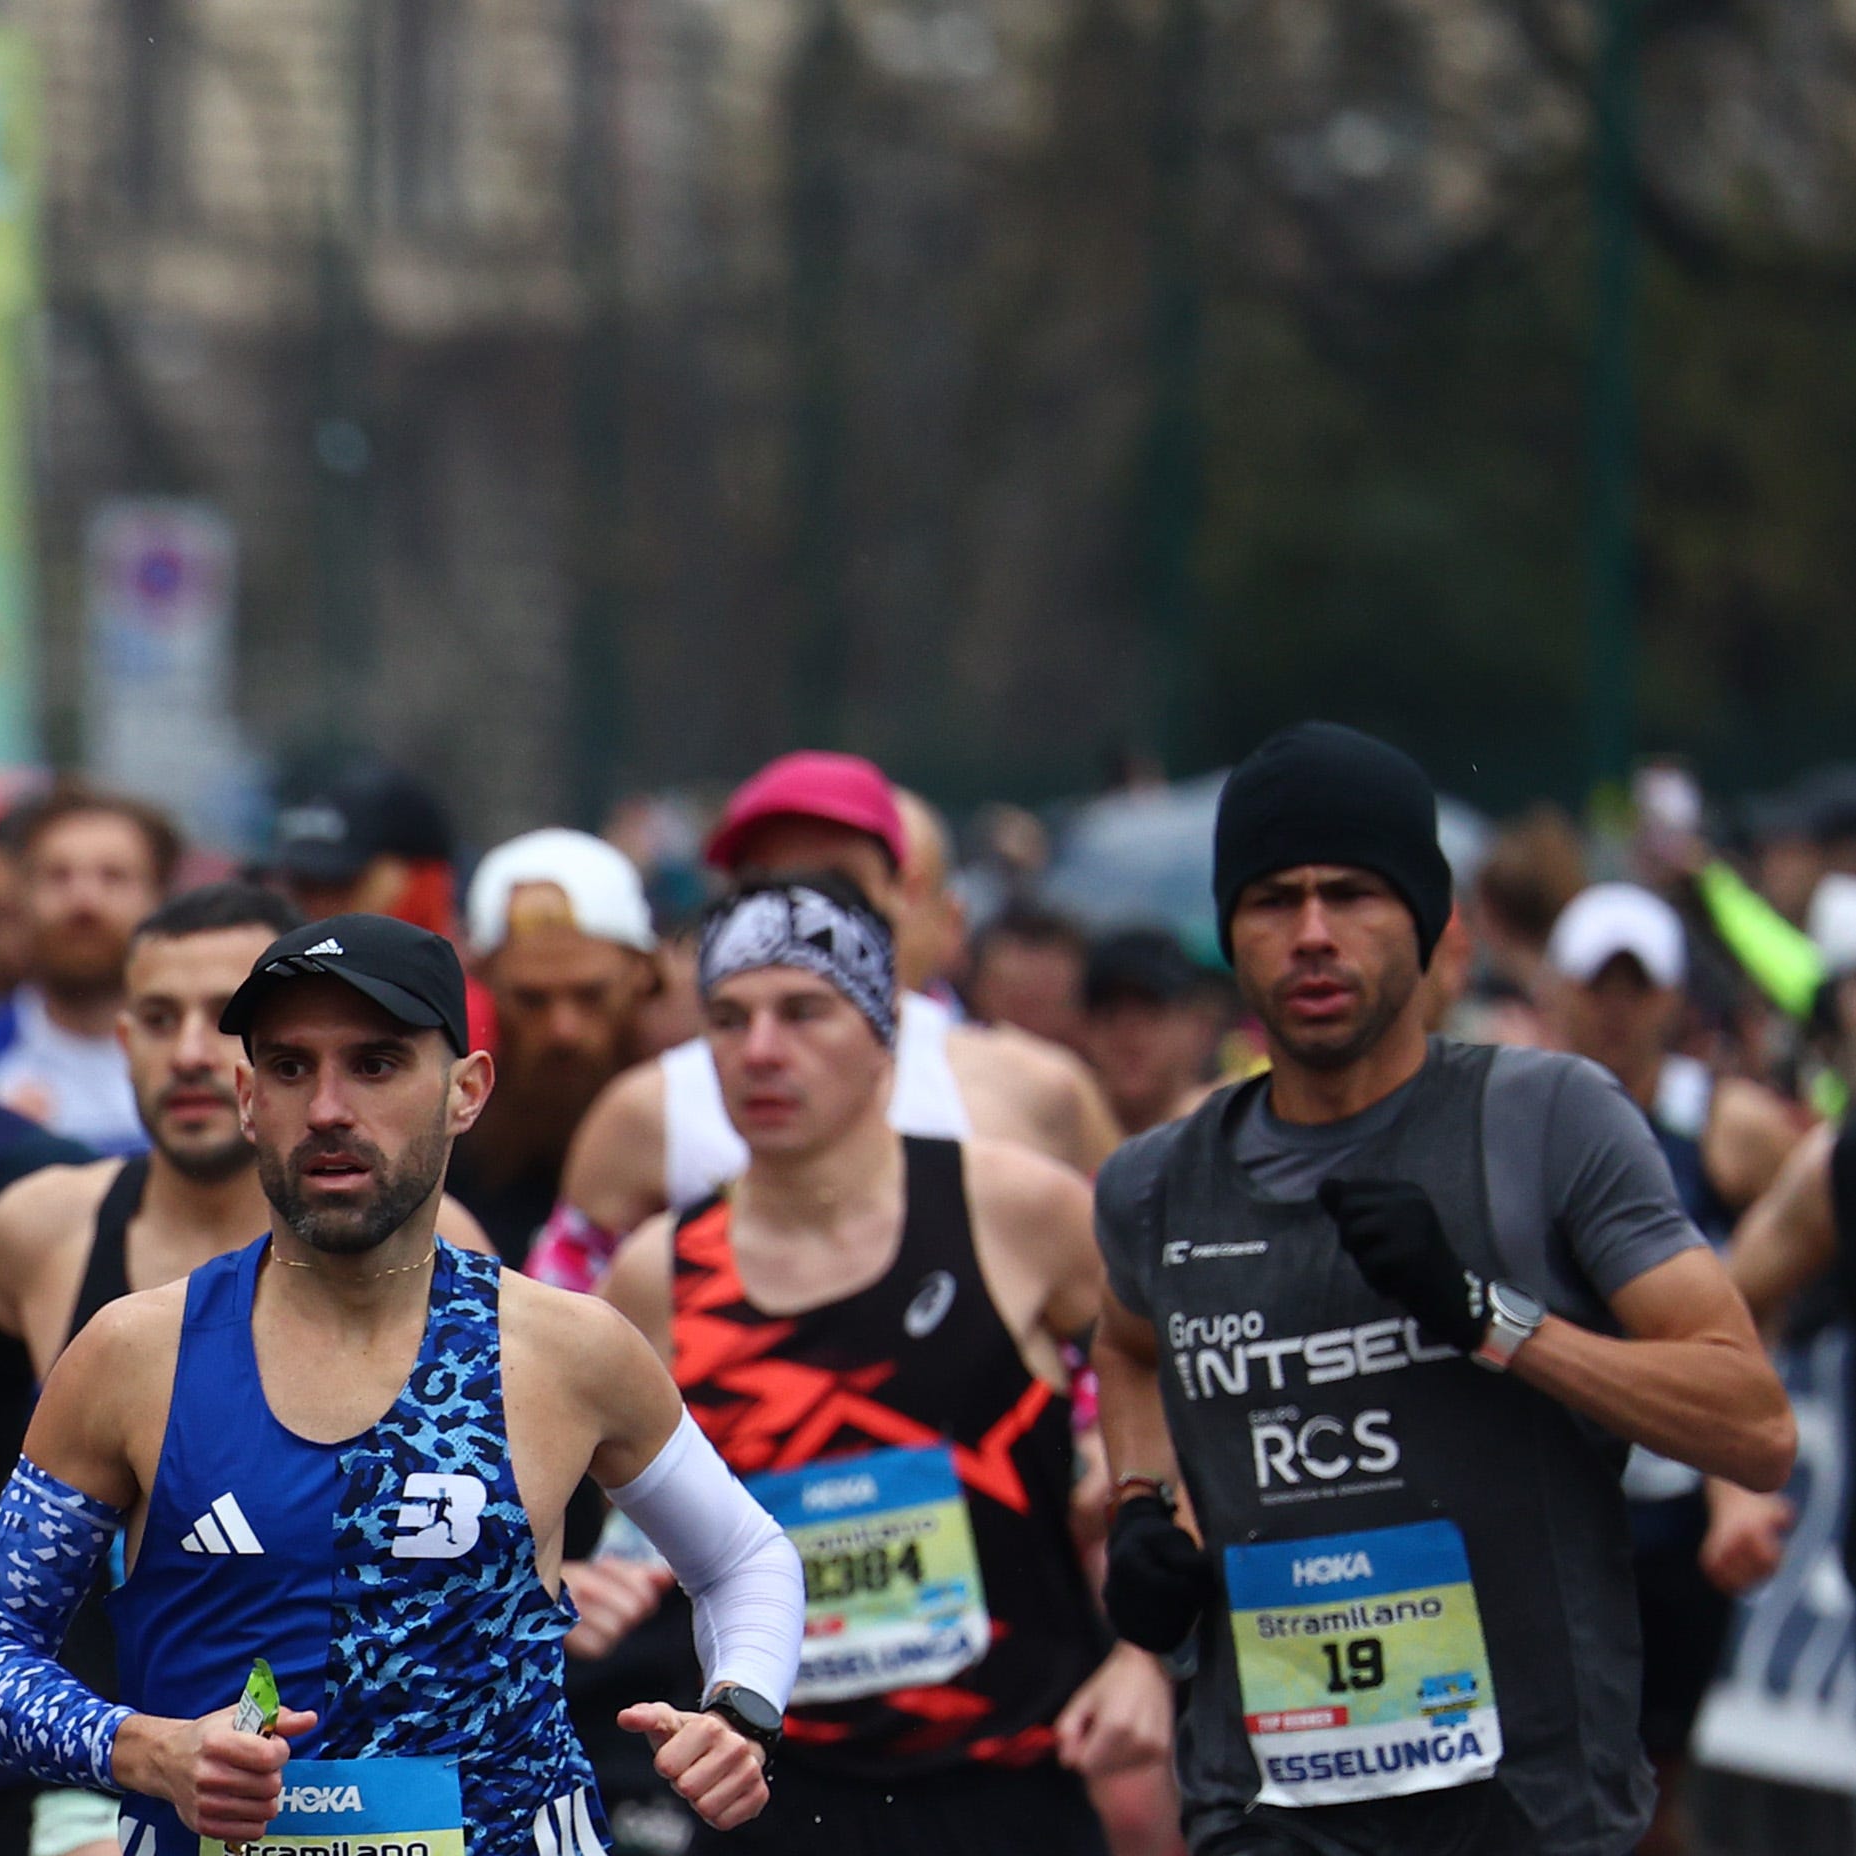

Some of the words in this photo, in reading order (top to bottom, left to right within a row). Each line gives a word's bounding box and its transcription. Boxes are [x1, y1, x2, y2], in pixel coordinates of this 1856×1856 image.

[1168, 1309, 1265, 1350] Grupo
[1251, 1408, 1401, 1488] RCS
[1292, 1550, 1374, 1587] HOKA
[1255, 1596, 1444, 1640] Stramilano
[1321, 1637, 1385, 1694] 19
[1267, 1730, 1484, 1785] ESSELUNGA
[277, 1785, 364, 1814] HOKA
